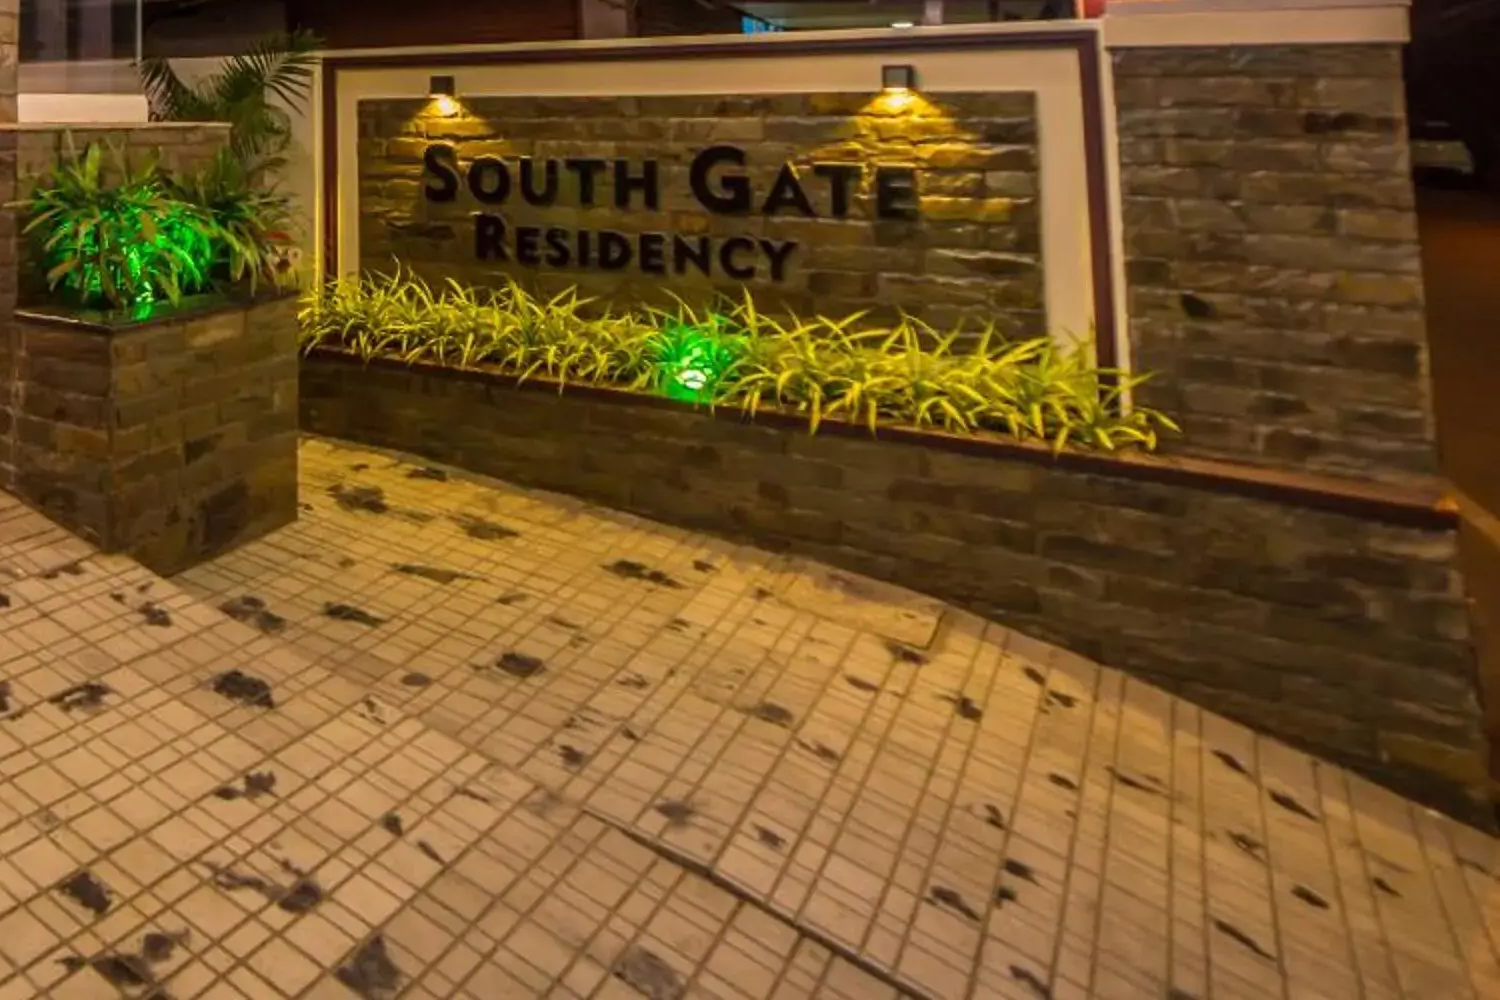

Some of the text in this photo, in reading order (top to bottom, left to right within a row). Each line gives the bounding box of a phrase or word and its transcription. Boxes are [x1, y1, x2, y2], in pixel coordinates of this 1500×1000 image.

[422, 142, 918, 222] SOUTH GATE
[472, 212, 798, 282] RESIDENCY
